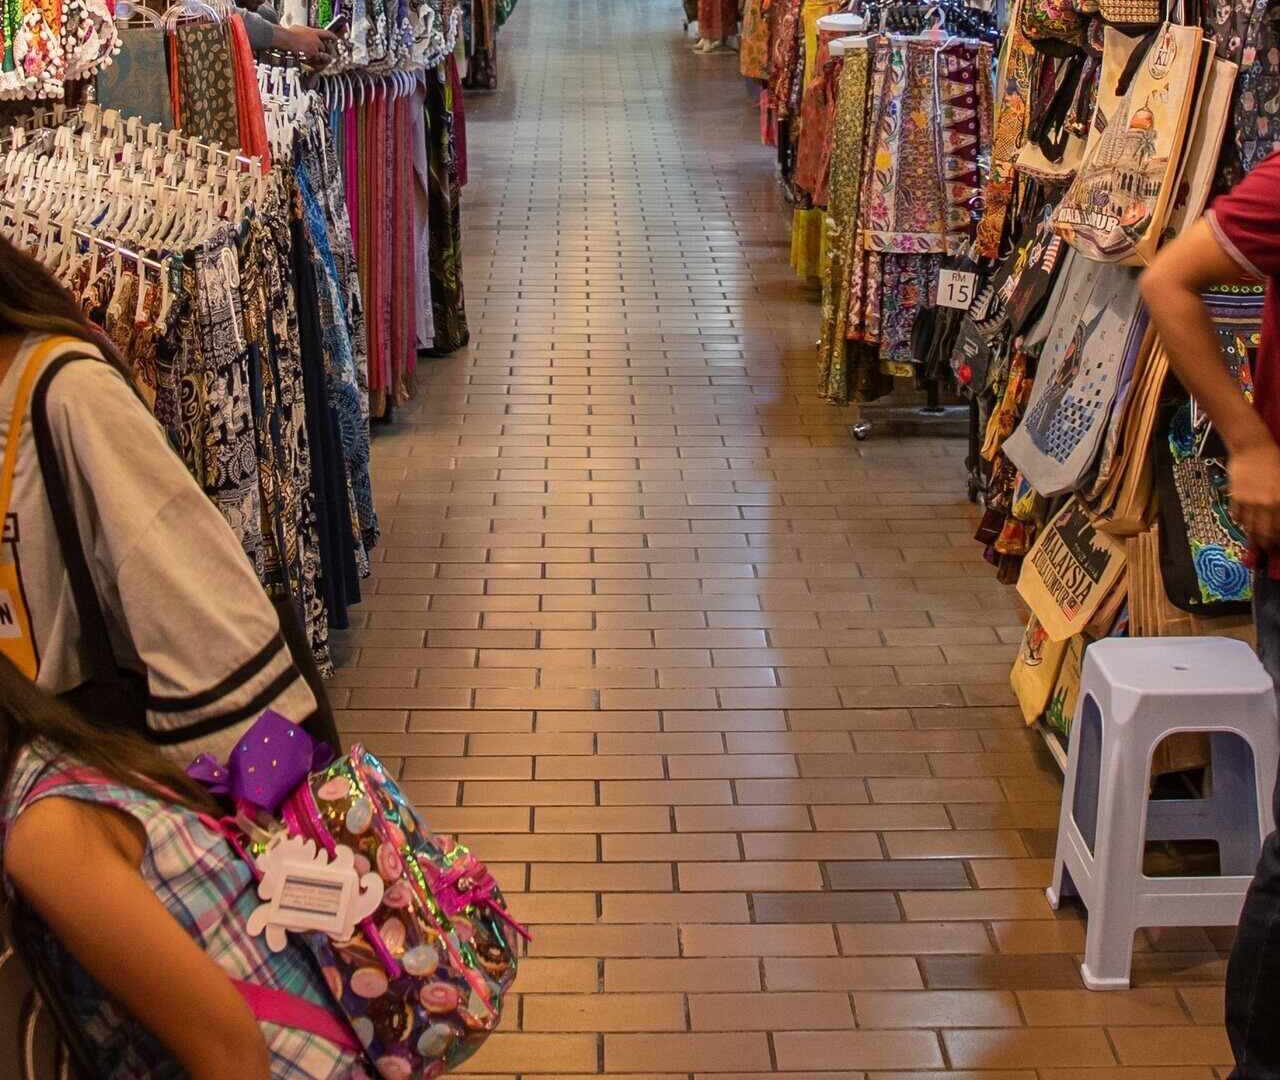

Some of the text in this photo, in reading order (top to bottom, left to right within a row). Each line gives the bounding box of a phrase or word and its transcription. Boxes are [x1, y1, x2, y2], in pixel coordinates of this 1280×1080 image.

[951, 272, 966, 283] RM
[947, 283, 969, 303] 15
[1041, 526, 1093, 606] MALAYSIA
